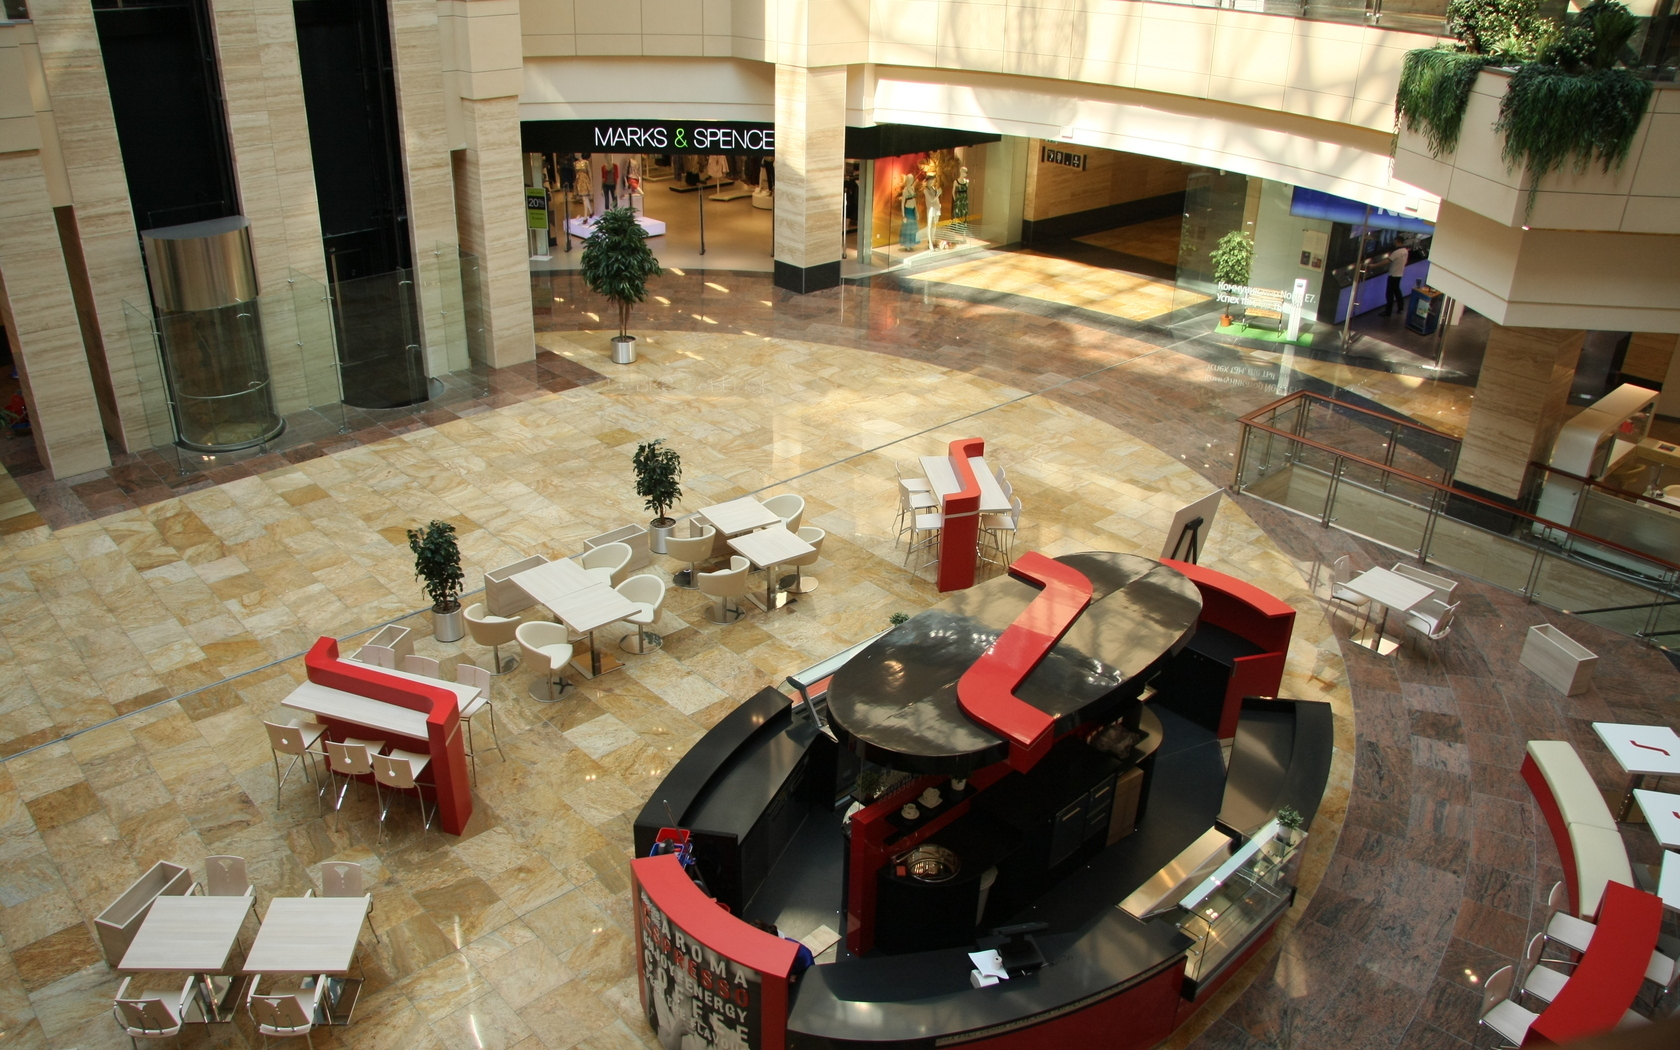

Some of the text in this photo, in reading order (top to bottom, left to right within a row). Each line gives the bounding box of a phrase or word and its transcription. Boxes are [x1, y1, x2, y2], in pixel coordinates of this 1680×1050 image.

[594, 127, 668, 148] MARKS
[674, 128, 688, 148] &
[1217, 281, 1278, 299] Коммуник
[1281, 290, 1302, 302] Noa
[661, 919, 748, 989] AROMA
[690, 1016, 745, 1050] FLAVOU
